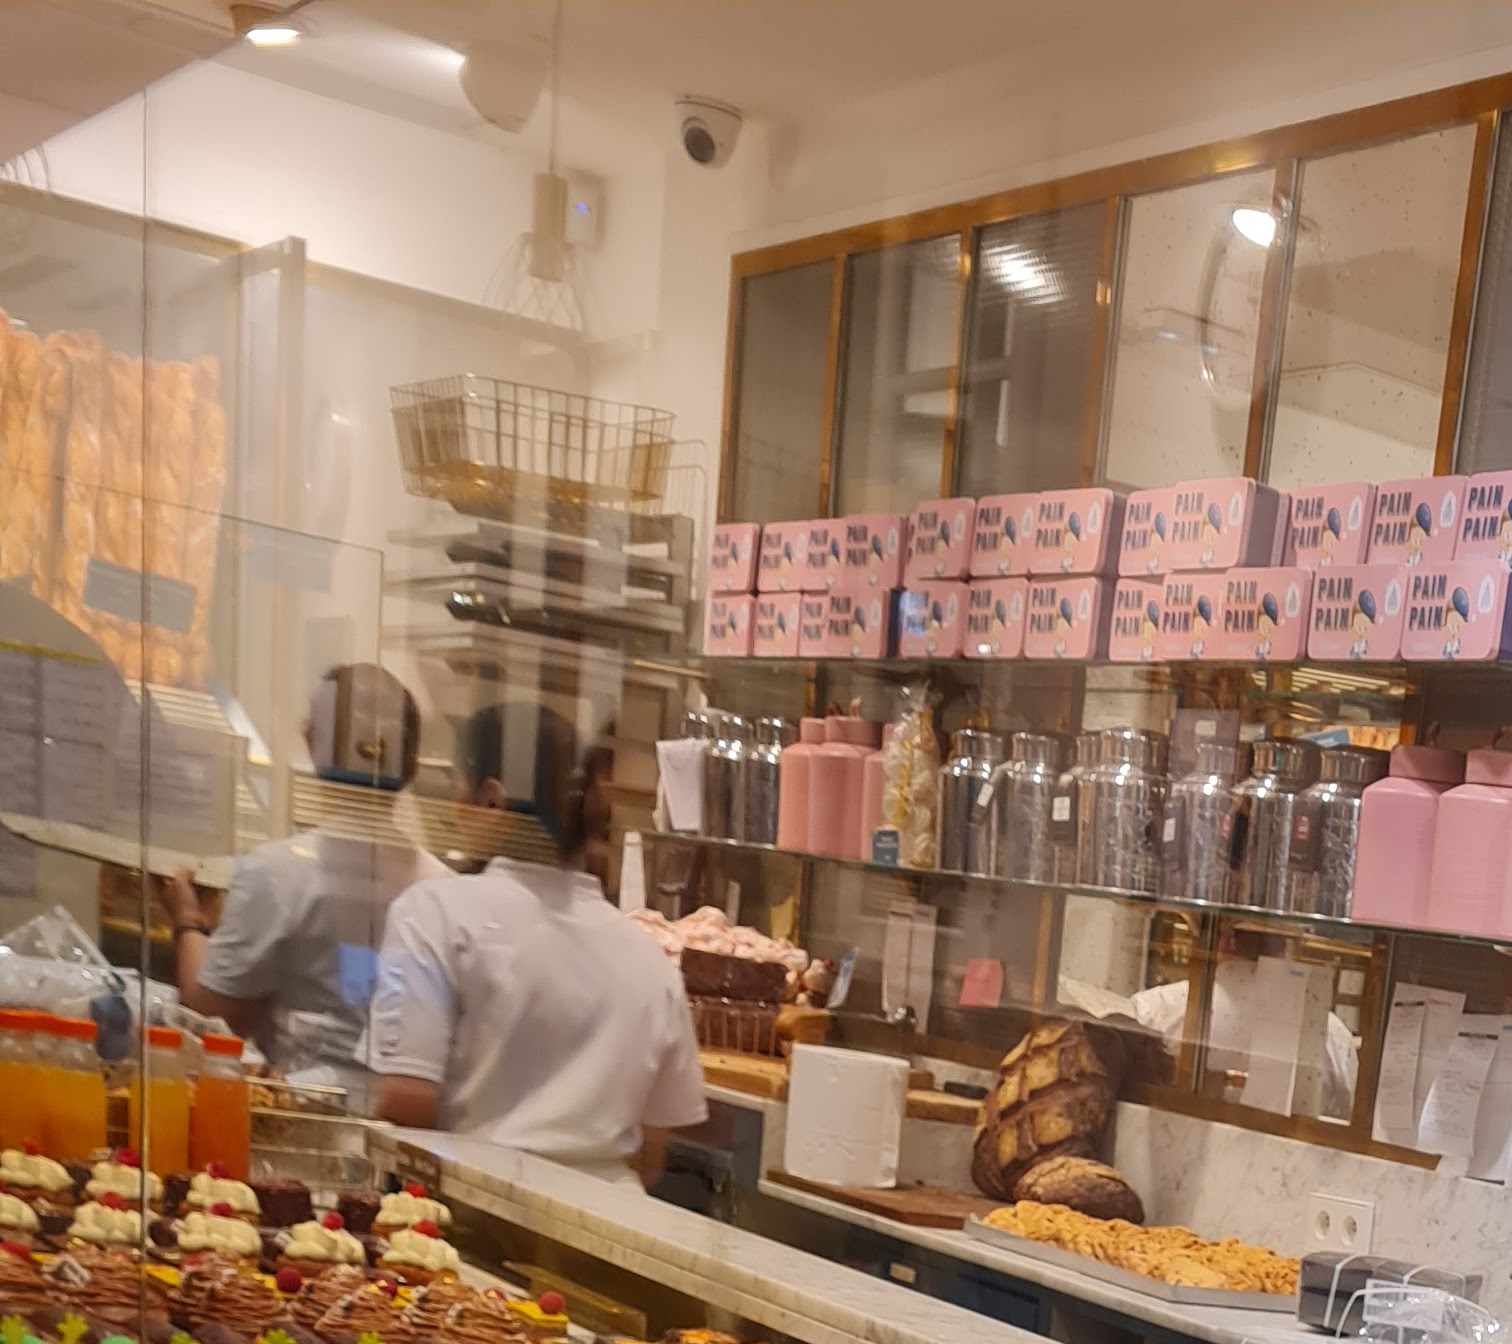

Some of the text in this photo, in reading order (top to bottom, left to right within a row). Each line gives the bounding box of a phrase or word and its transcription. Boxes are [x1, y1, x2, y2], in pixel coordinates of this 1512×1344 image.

[1175, 492, 1204, 515] PAIN
[1295, 496, 1324, 520] PAIN
[1379, 491, 1412, 517] PAIN
[1468, 485, 1504, 512] PAIN
[1172, 520, 1200, 543] PAIN
[1292, 526, 1320, 550] PAIN
[1374, 522, 1407, 546] PAIN
[1462, 515, 1500, 542] PAIN
[1166, 583, 1193, 605] PAIN
[1226, 581, 1258, 605] PAIN
[1318, 577, 1353, 602] PAIN
[1412, 574, 1447, 600] PAIN
[1163, 611, 1191, 633] PAIN
[1224, 609, 1255, 633] PAIN
[1315, 607, 1350, 632] PAIN
[1408, 606, 1443, 631] PAIN
